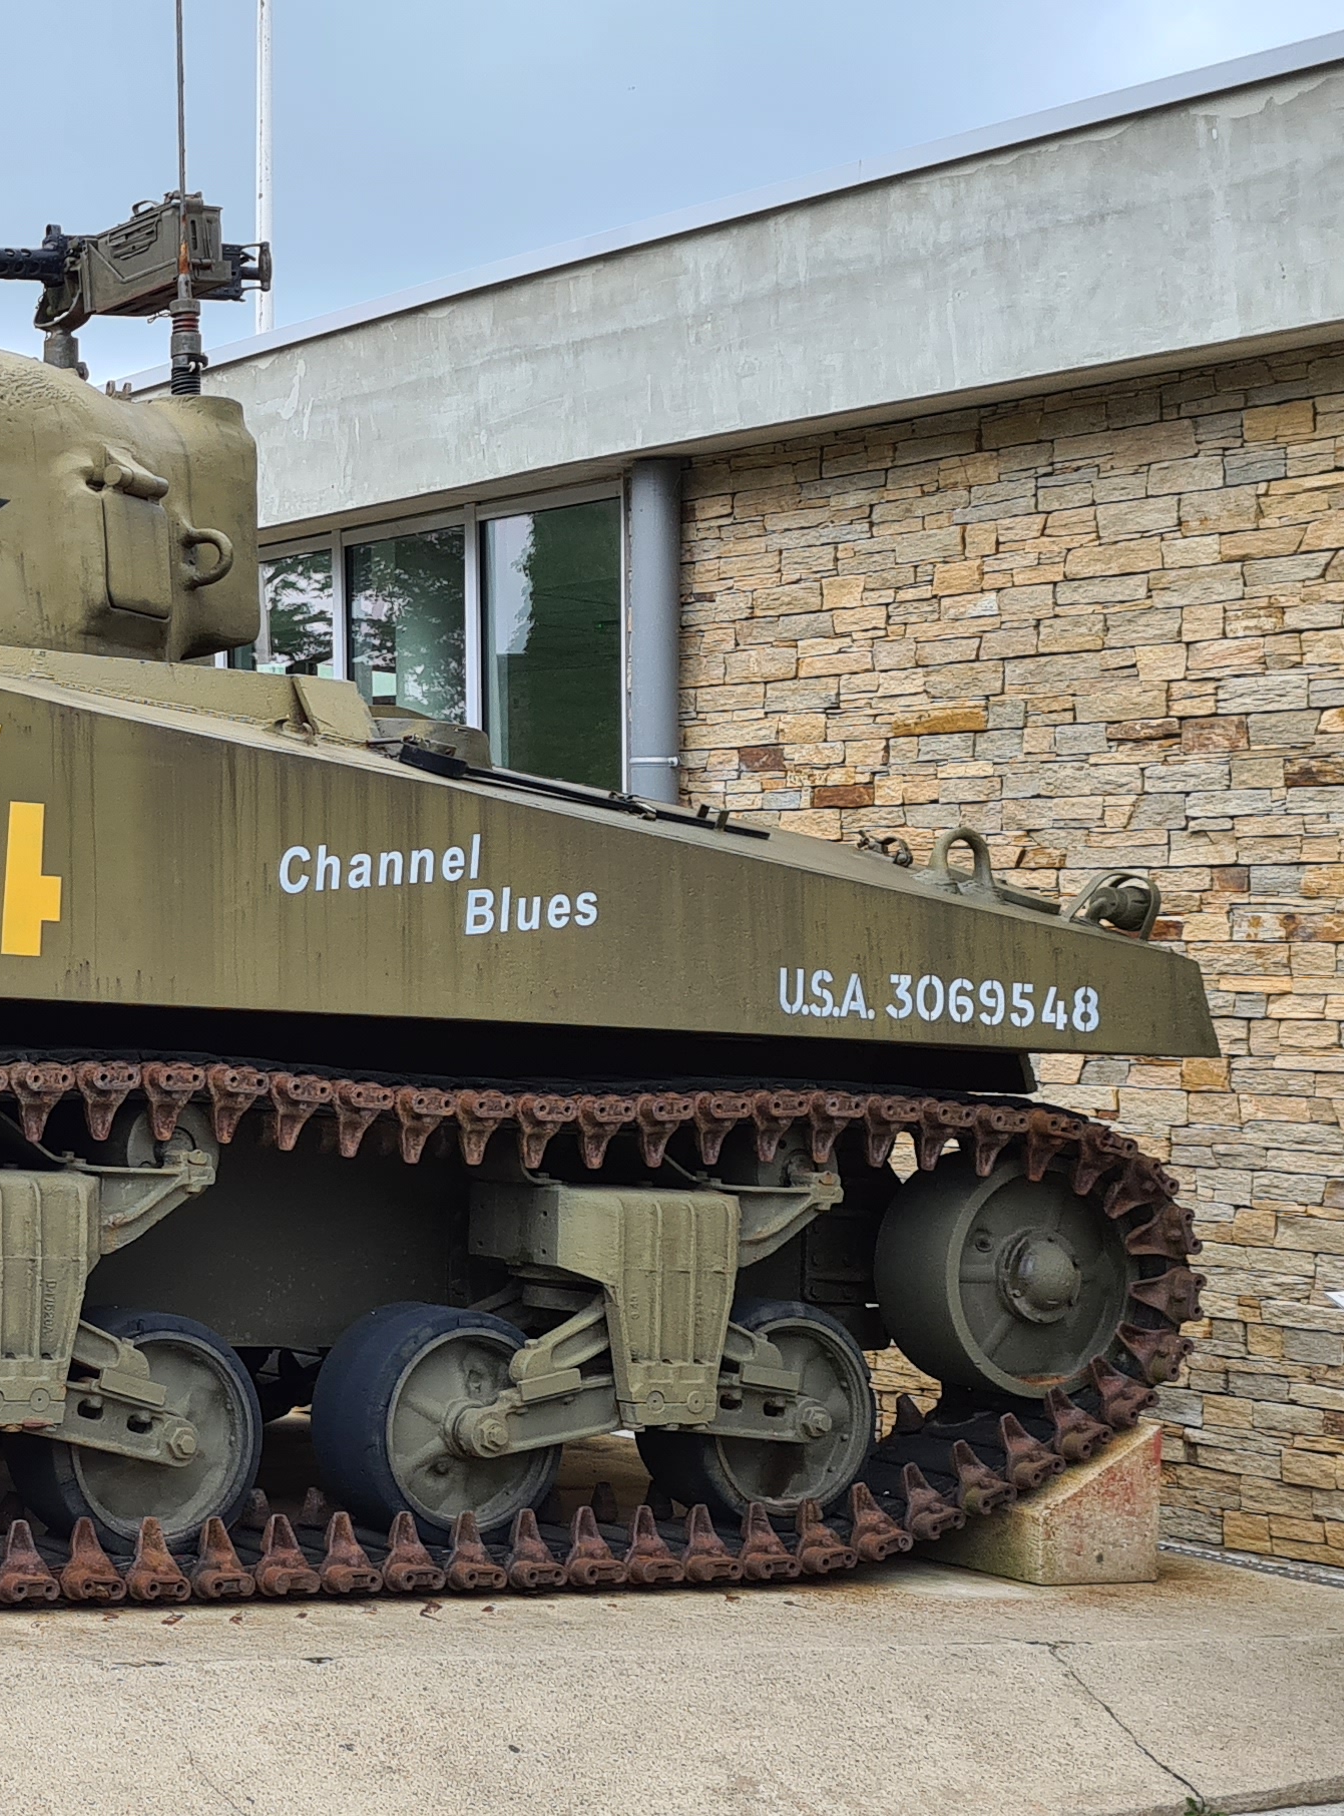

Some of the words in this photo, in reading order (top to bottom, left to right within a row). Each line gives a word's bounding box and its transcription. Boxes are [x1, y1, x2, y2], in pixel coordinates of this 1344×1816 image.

[278, 832, 482, 895] Channel
[464, 886, 599, 936] Blues
[778, 966, 876, 1021] U.S.A.
[883, 973, 1100, 1033] 3069548
